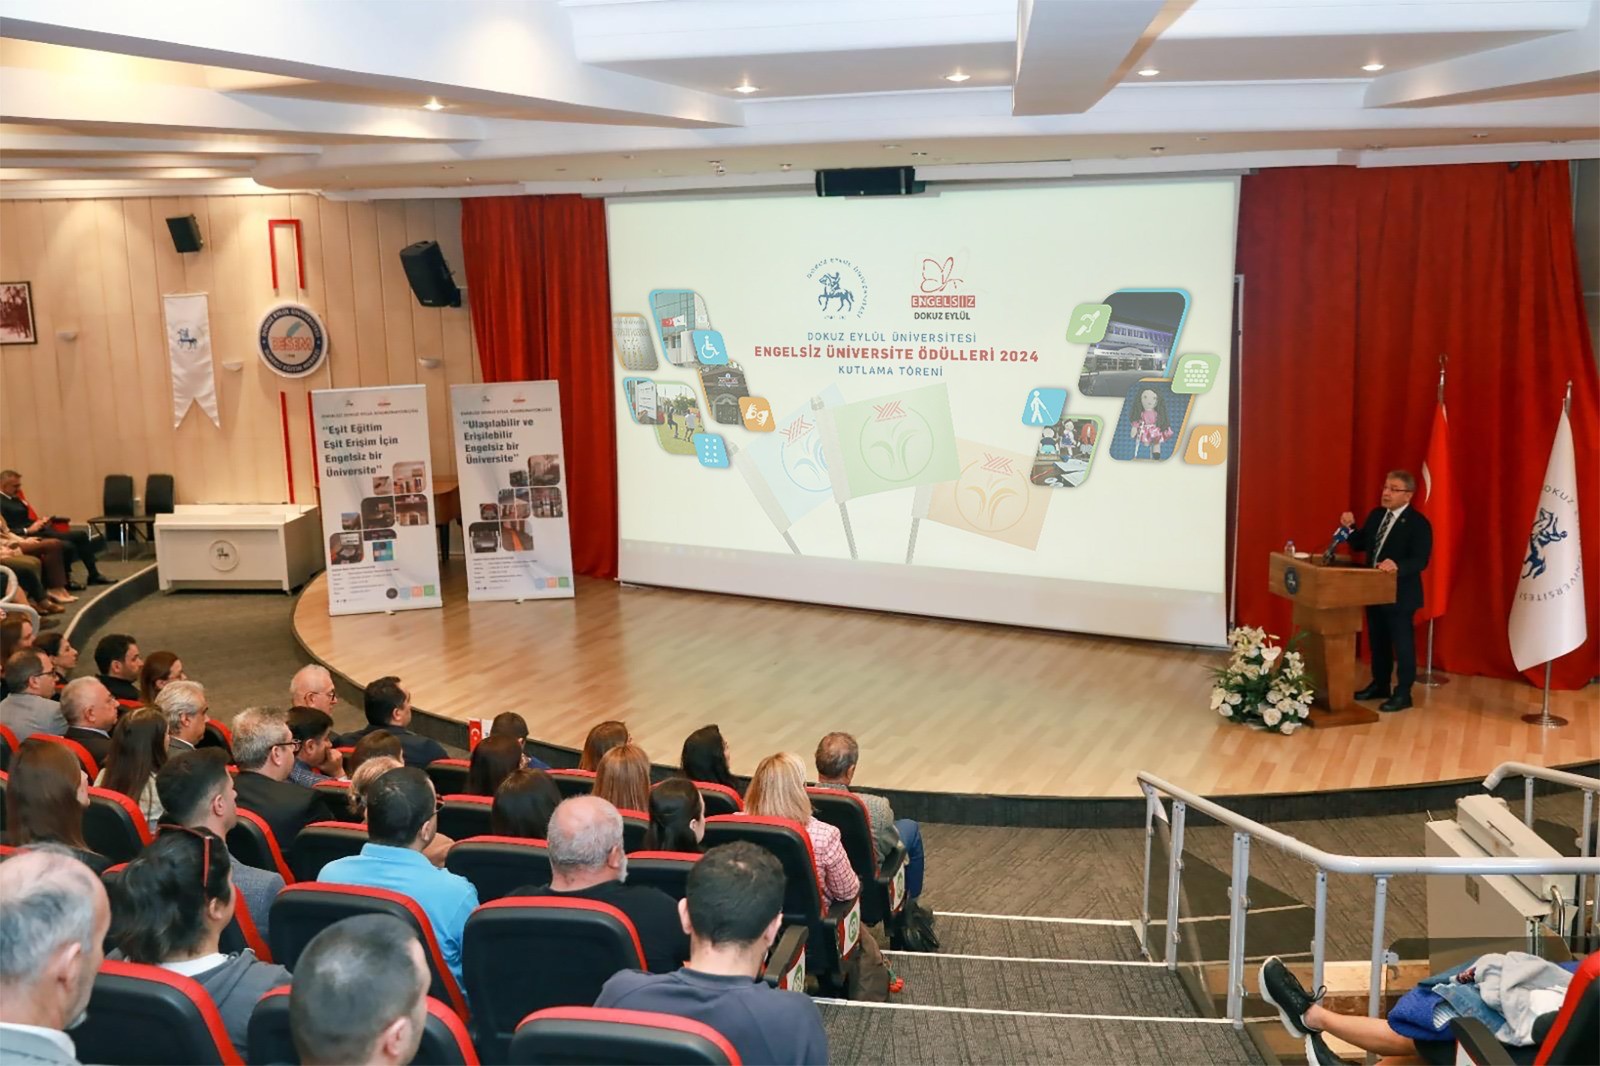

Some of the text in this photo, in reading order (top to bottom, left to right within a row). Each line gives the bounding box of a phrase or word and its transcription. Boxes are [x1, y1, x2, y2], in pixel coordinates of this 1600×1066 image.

[914, 310, 970, 320] DOKUZ EYLÜL
[807, 331, 977, 343] DOKUZ EYLÜL ÜNİVERSİTESİ
[754, 344, 1039, 362] ENGELSİZ ÜNİVERSİTE ÖDÜLLERİ 2024
[838, 365, 943, 377] KUTLAMA TÖRENİ
[350, 423, 383, 434] Eğitim
[323, 434, 399, 450] Eşit Erişim İçin
[463, 430, 513, 442] Erişilebilir
[465, 442, 519, 454] Engelsiz bir
[324, 451, 383, 464] Engelsiz bir
[1544, 484, 1574, 504] OKUZ
